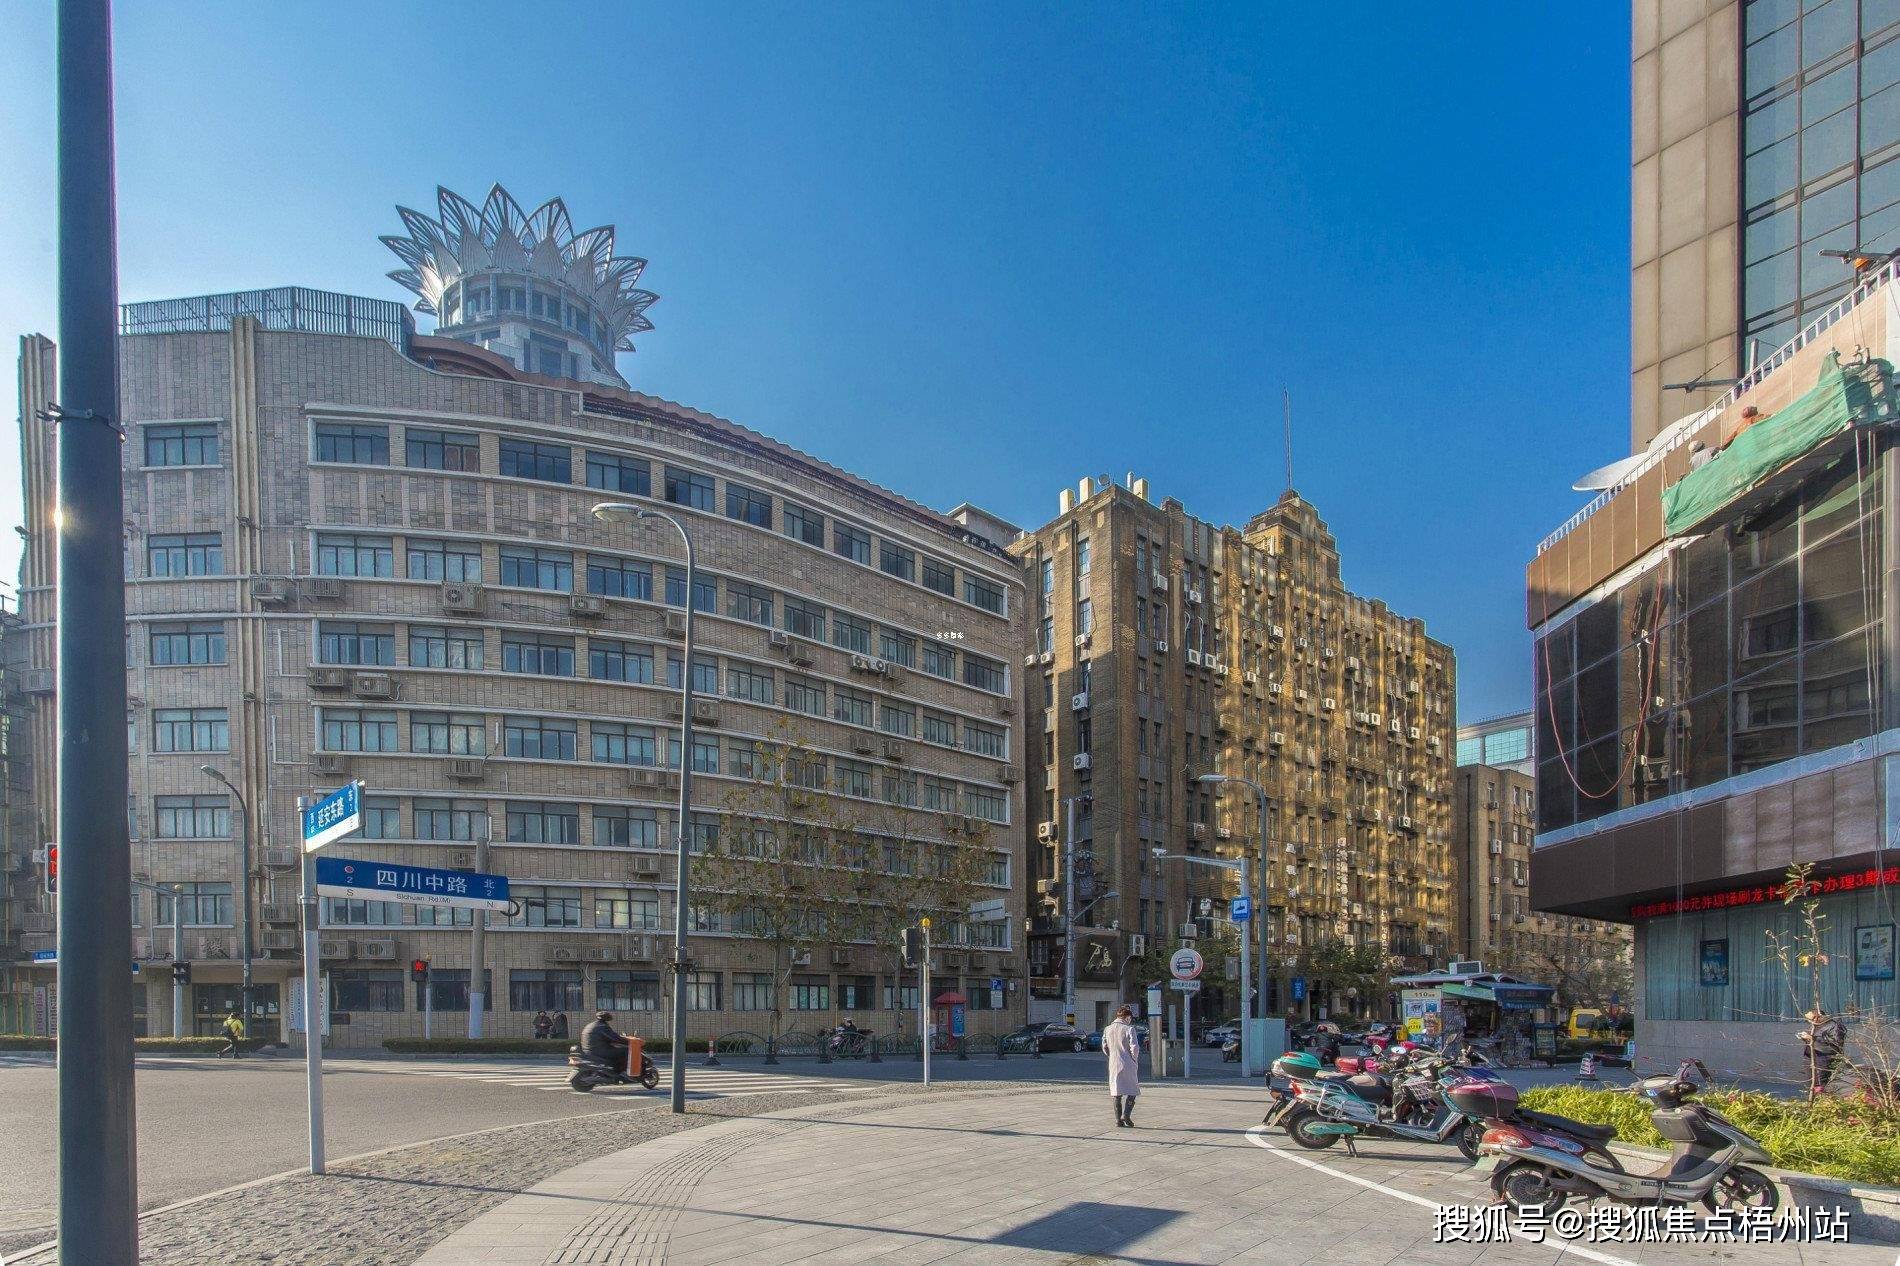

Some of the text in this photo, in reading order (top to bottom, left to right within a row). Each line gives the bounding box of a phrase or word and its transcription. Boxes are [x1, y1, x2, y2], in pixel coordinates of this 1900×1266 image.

[317, 796, 344, 828] 延安东路
[346, 876, 353, 884] 2
[377, 869, 468, 895] 四川中路
[483, 878, 496, 890] 北
[346, 889, 354, 897] S
